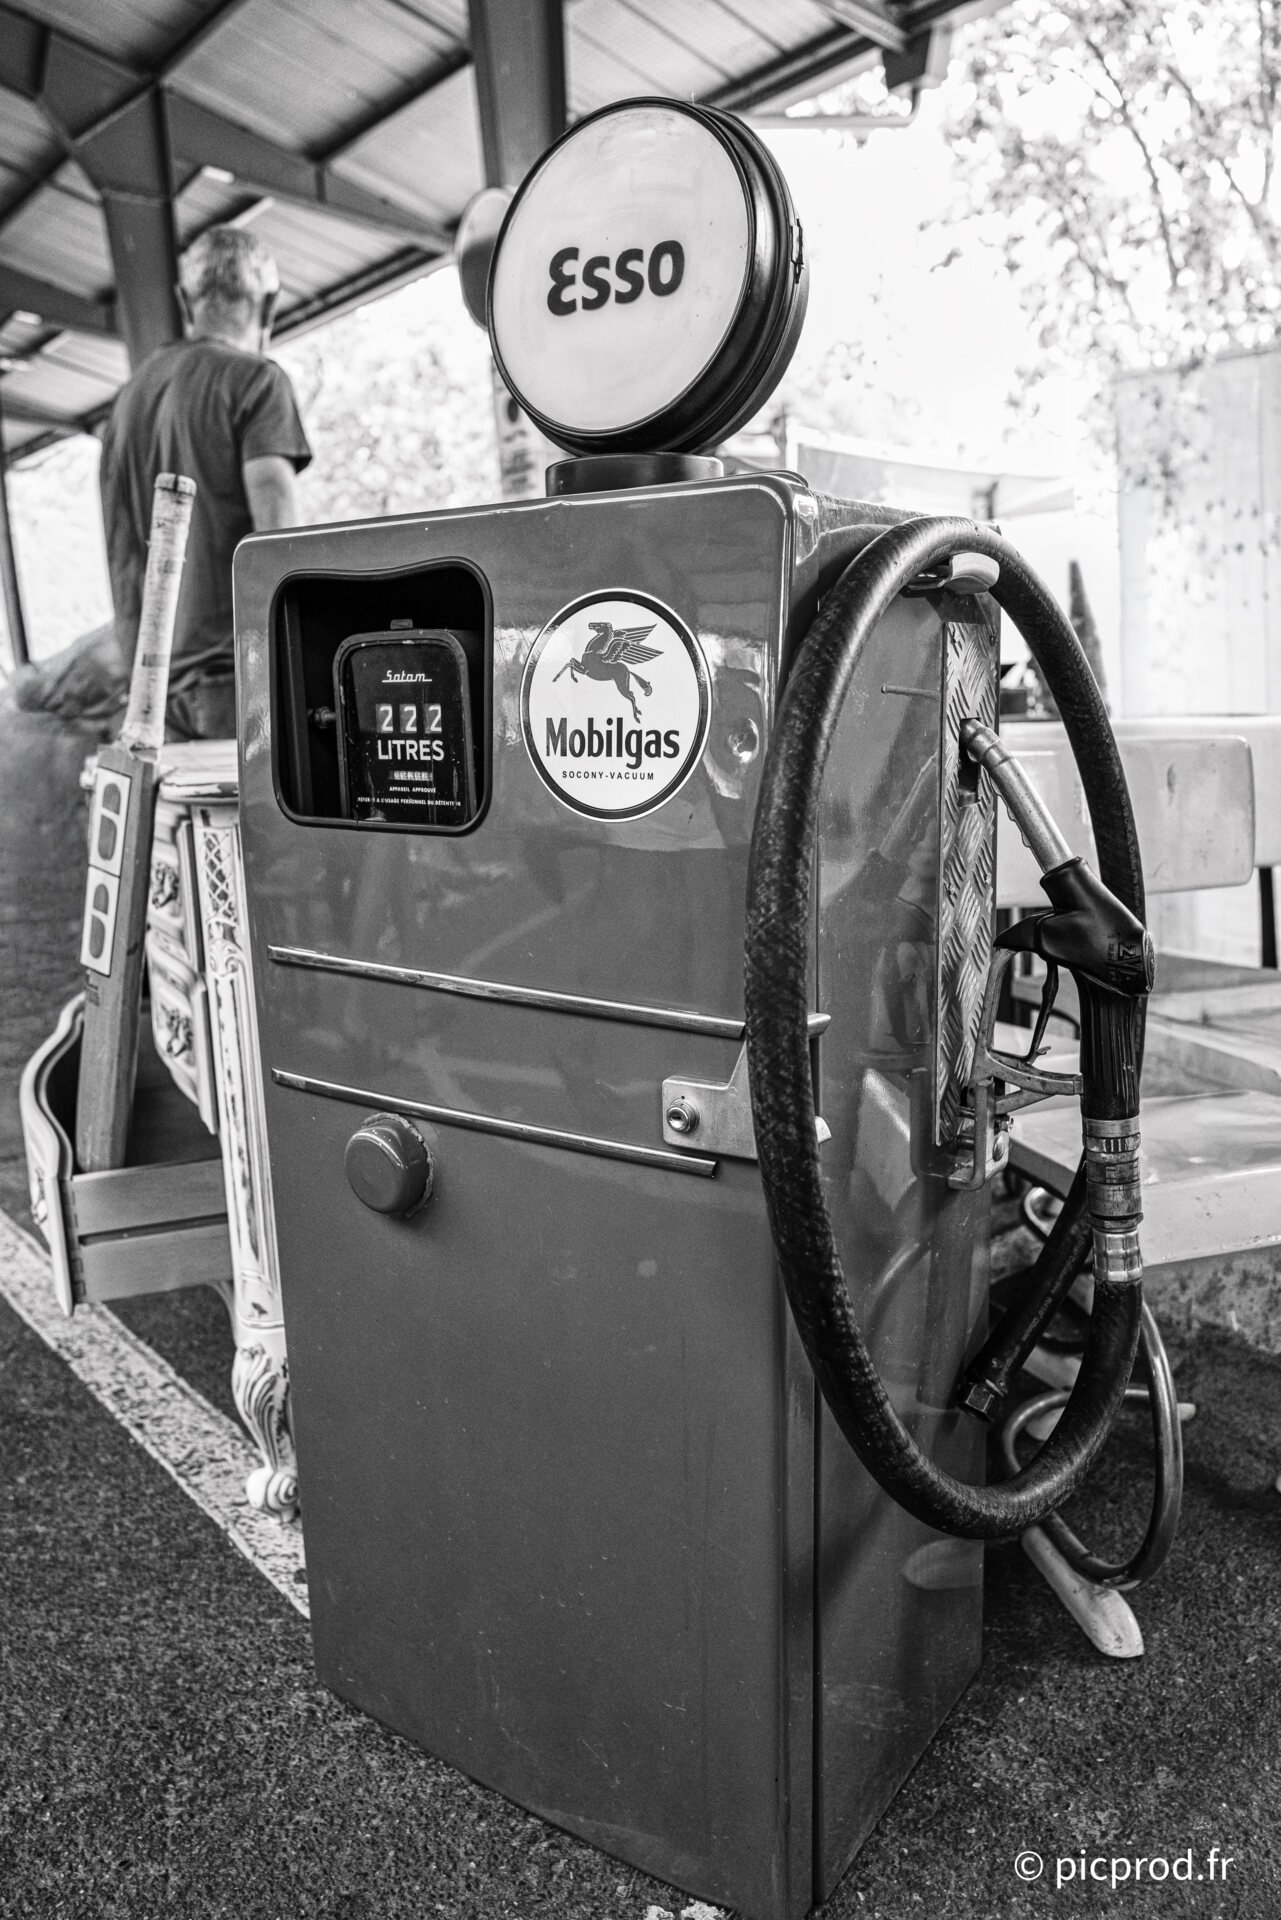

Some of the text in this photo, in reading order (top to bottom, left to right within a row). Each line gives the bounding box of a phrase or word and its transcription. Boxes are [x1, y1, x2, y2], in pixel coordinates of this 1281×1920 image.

[382, 670, 433, 683] Satam
[377, 739, 445, 761] LITRES
[545, 717, 680, 770] Mobilgas
[562, 770, 654, 781] SOCONY-VACUUM
